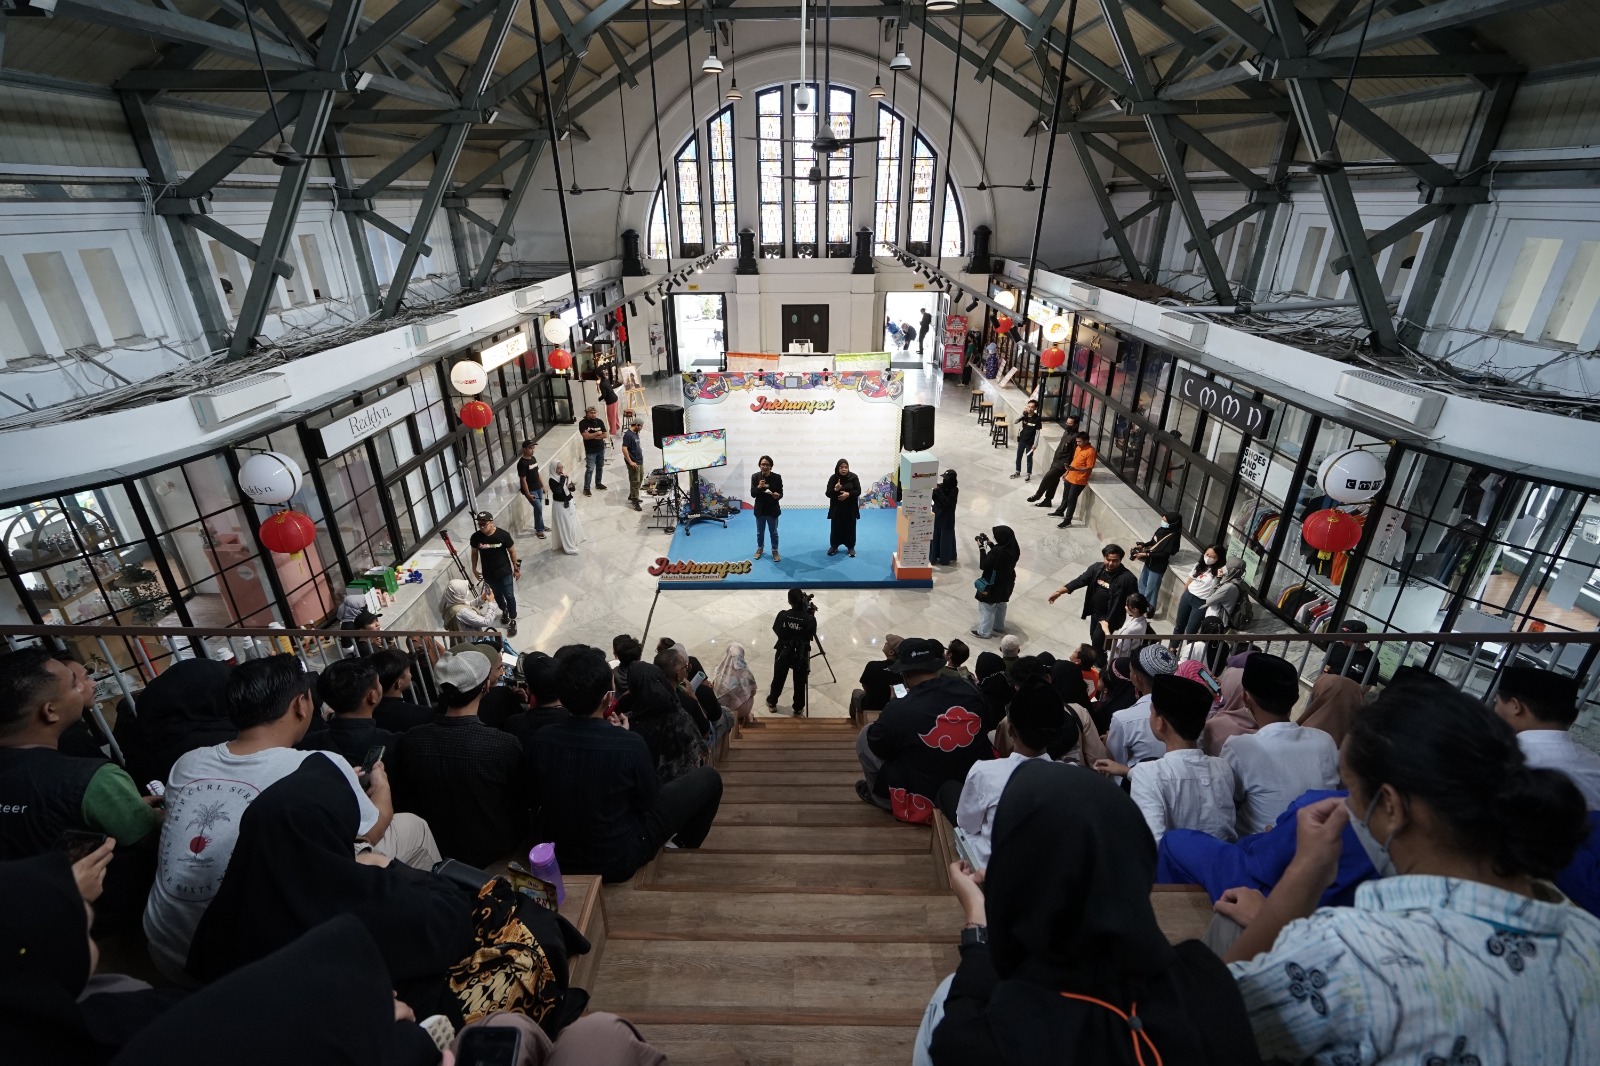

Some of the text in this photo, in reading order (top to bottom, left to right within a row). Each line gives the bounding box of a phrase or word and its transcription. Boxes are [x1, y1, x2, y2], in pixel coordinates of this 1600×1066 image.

[750, 395, 835, 415] Jakhumfest
[1242, 457, 1257, 471] AND
[1244, 448, 1267, 467] SHOES
[648, 557, 752, 579] Jakhumfest
[174, 798, 186, 821] RIP
[188, 784, 222, 796] CURL
